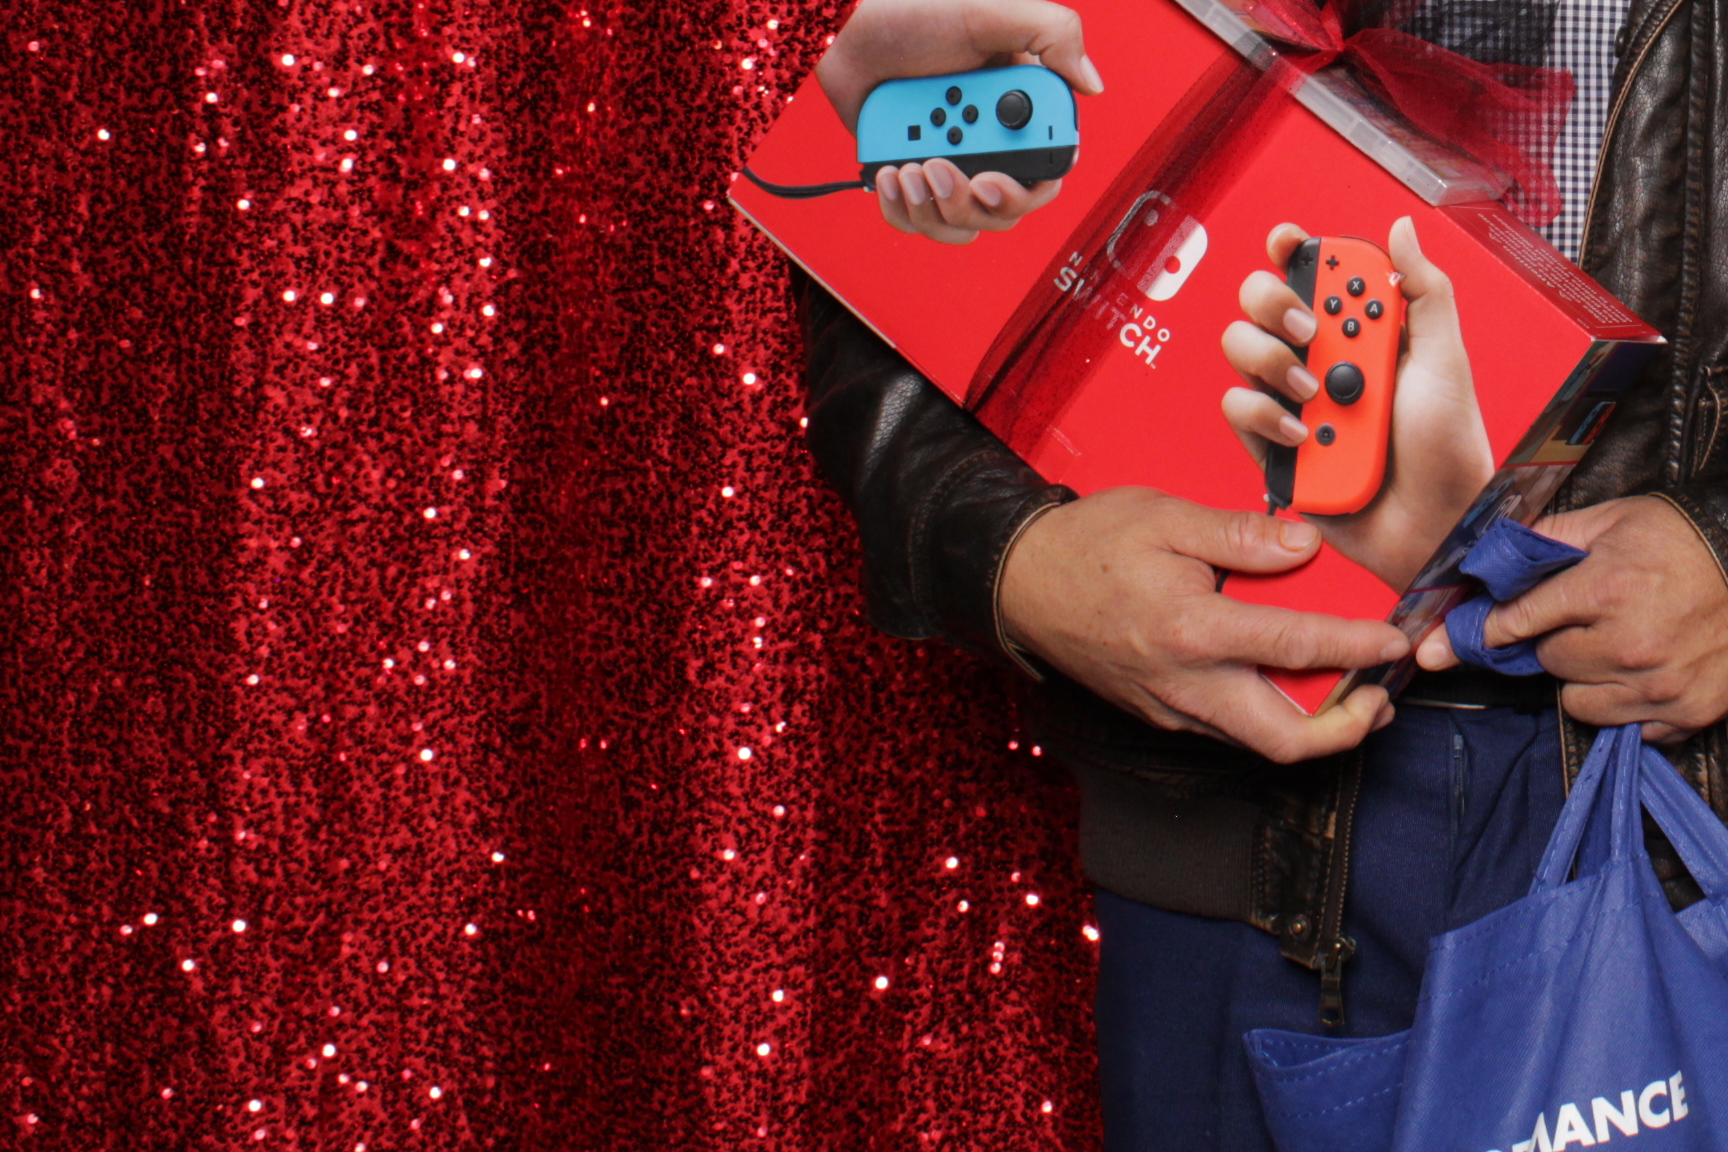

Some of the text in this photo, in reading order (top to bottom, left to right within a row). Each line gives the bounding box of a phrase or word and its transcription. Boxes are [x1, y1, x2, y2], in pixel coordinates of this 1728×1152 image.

[1352, 280, 1360, 290] X
[1330, 299, 1338, 309] Y
[1369, 303, 1379, 314] A
[1347, 321, 1355, 332] B
